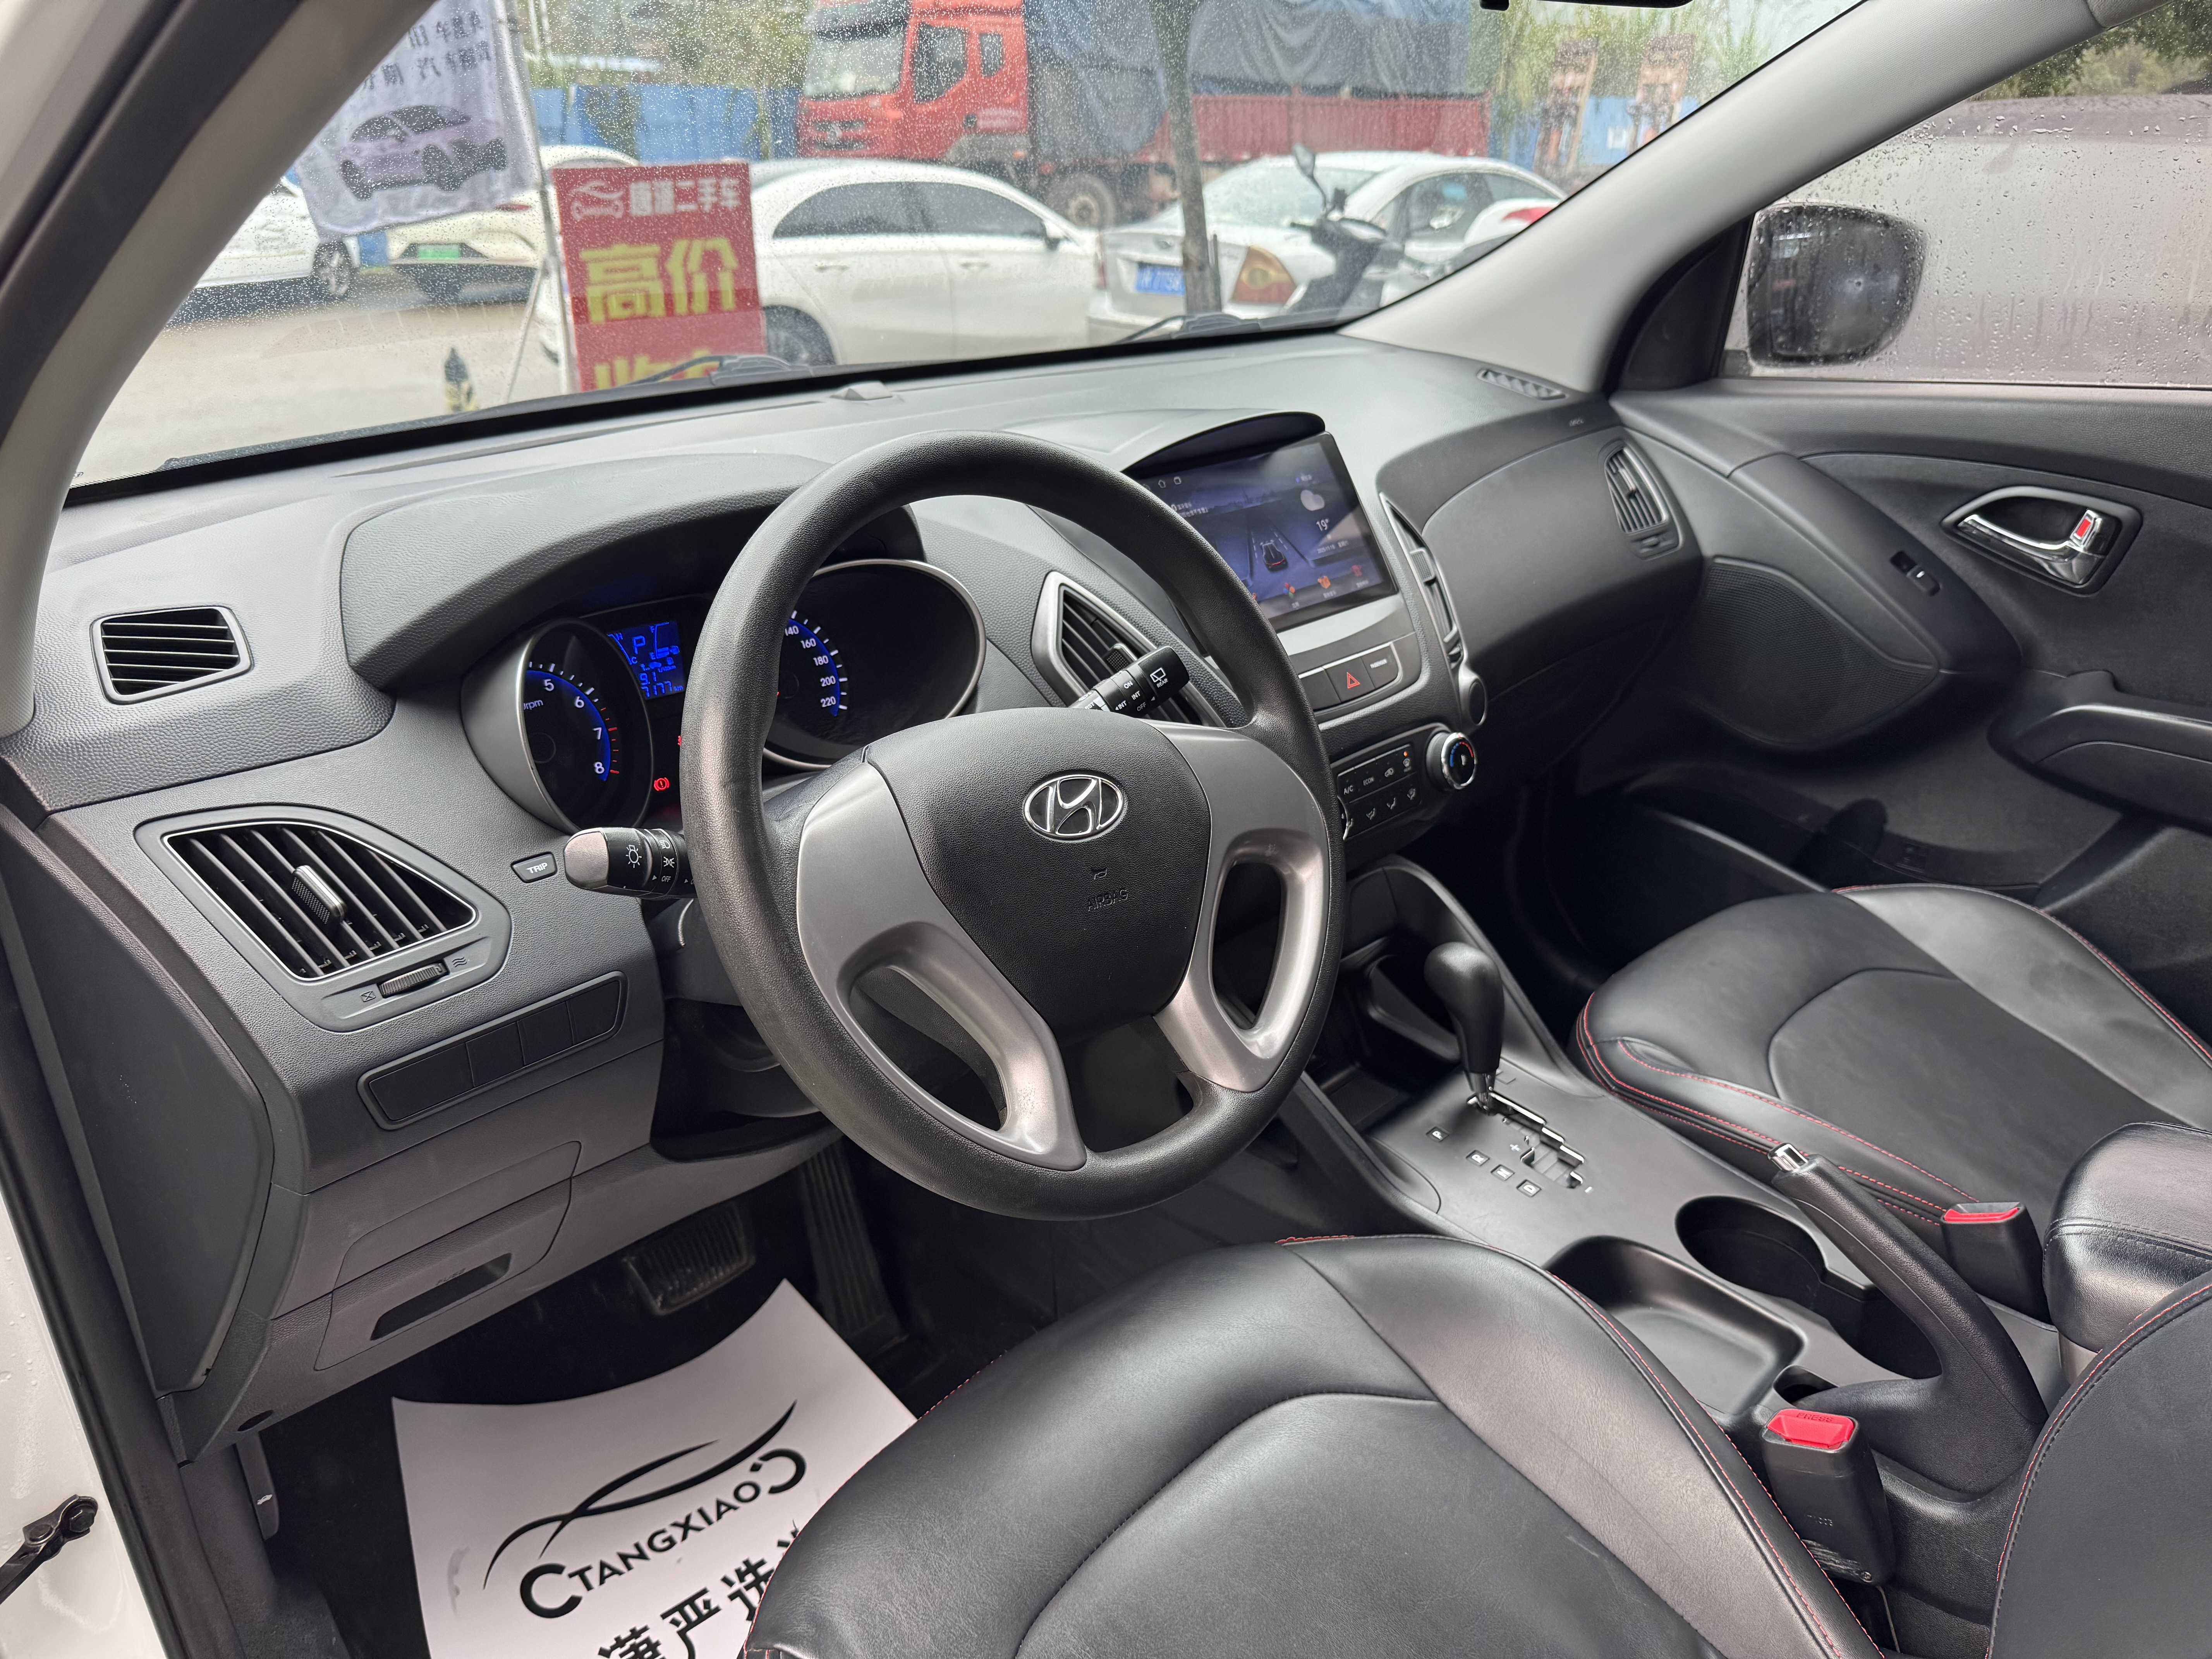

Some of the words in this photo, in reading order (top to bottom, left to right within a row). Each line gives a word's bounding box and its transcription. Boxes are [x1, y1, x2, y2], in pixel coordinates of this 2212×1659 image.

[580, 237, 738, 325] 高价
[785, 625, 799, 636] 140
[632, 635, 646, 654] P
[800, 638, 816, 649] 160
[813, 655, 829, 666] 180
[544, 678, 555, 692] 5
[820, 675, 836, 687] 200
[1123, 680, 1133, 689] ON
[1156, 678, 1168, 688] REAR
[1131, 691, 1140, 700] INT
[575, 696, 585, 708] 6
[821, 696, 836, 708] 220
[1118, 700, 1127, 710] INT
[1137, 702, 1147, 711] OFF
[592, 727, 602, 740] 7
[594, 761, 605, 774] 8
[1363, 776, 1374, 786] ECON
[1343, 785, 1354, 795] A/C
[526, 862, 548, 874] TRIP
[1088, 890, 1129, 911] AIRBAG
[1432, 1130, 1443, 1140] P
[1472, 1154, 1484, 1163] R
[1523, 1184, 1536, 1194] D
[1796, 1412, 1833, 1422] PRESS
